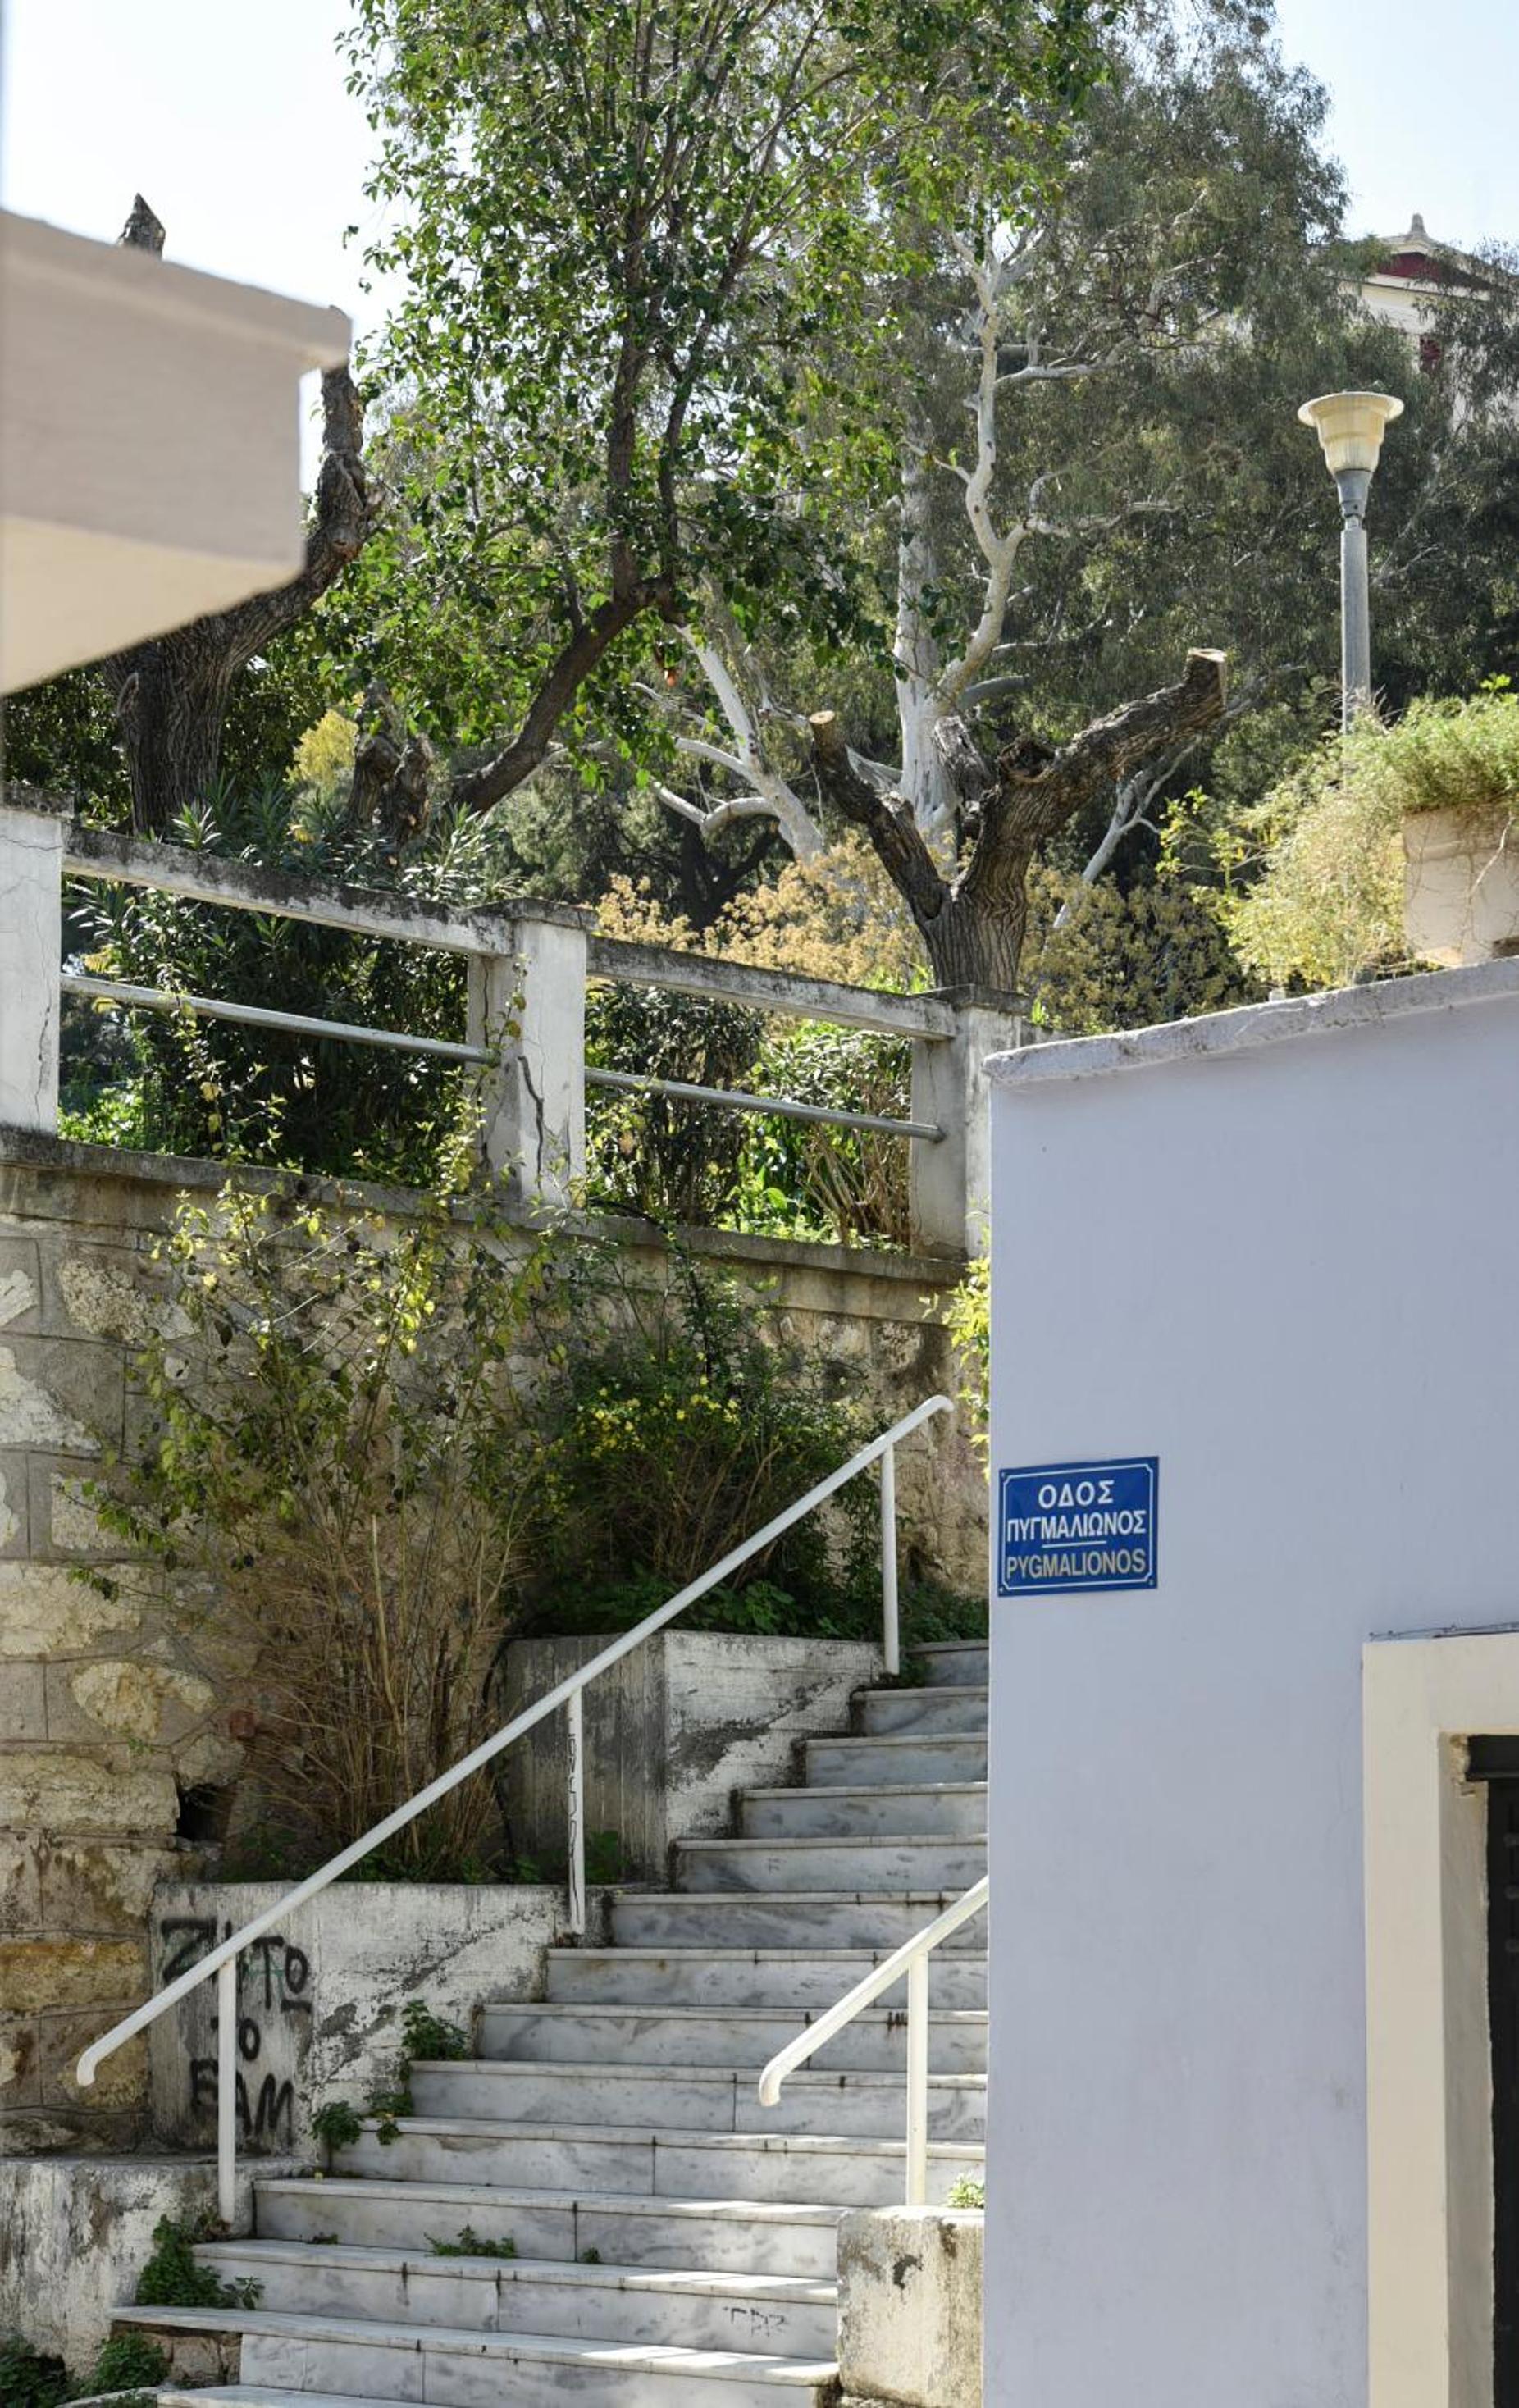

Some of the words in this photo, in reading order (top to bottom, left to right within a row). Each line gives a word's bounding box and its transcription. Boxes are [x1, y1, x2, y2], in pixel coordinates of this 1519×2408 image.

[1038, 1480, 1114, 1509] ΟΔΟΣ
[1007, 1510, 1147, 1542] ΠΥΓΜΑΛΙΩΝΟΣ
[1007, 1548, 1146, 1580] PYGMALIONOS
